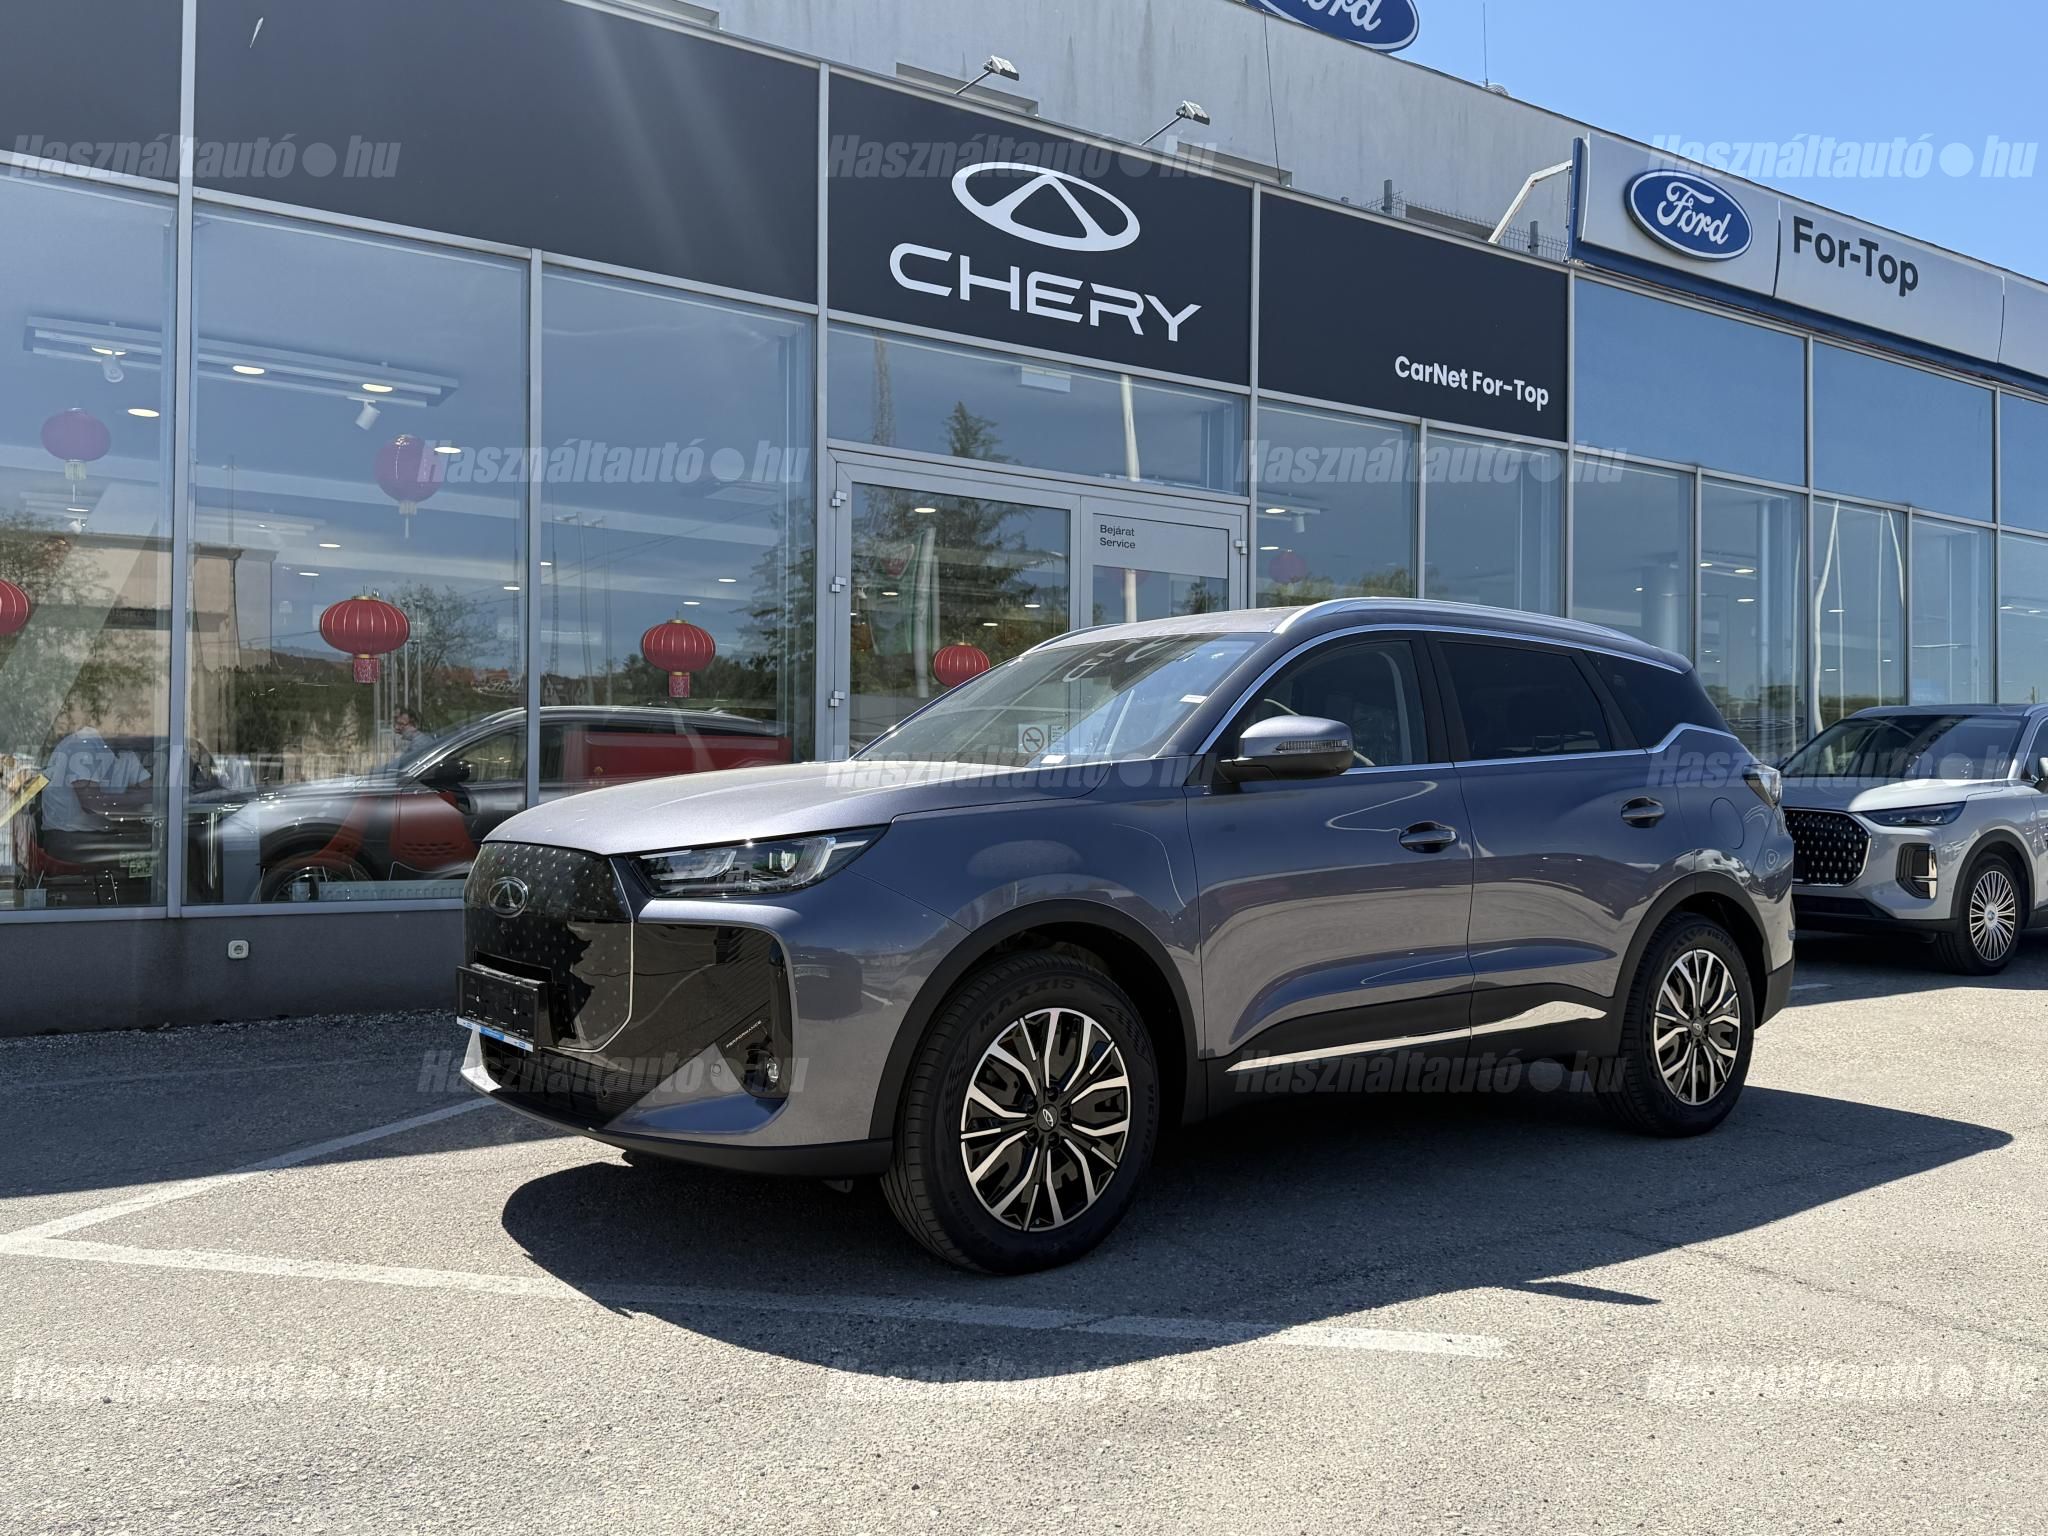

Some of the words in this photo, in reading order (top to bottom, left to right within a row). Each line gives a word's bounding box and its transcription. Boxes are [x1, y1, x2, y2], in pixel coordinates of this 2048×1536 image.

[1656, 181, 1731, 245] Ford
[1793, 215, 1919, 296] For-Top
[889, 243, 1202, 342] CHERY
[1394, 355, 1468, 391] CarNet
[1472, 370, 1549, 411] For-Top
[1099, 524, 1135, 537] Bejárat
[1099, 537, 1136, 549] Service
[979, 978, 1076, 1032] MAXXIS
